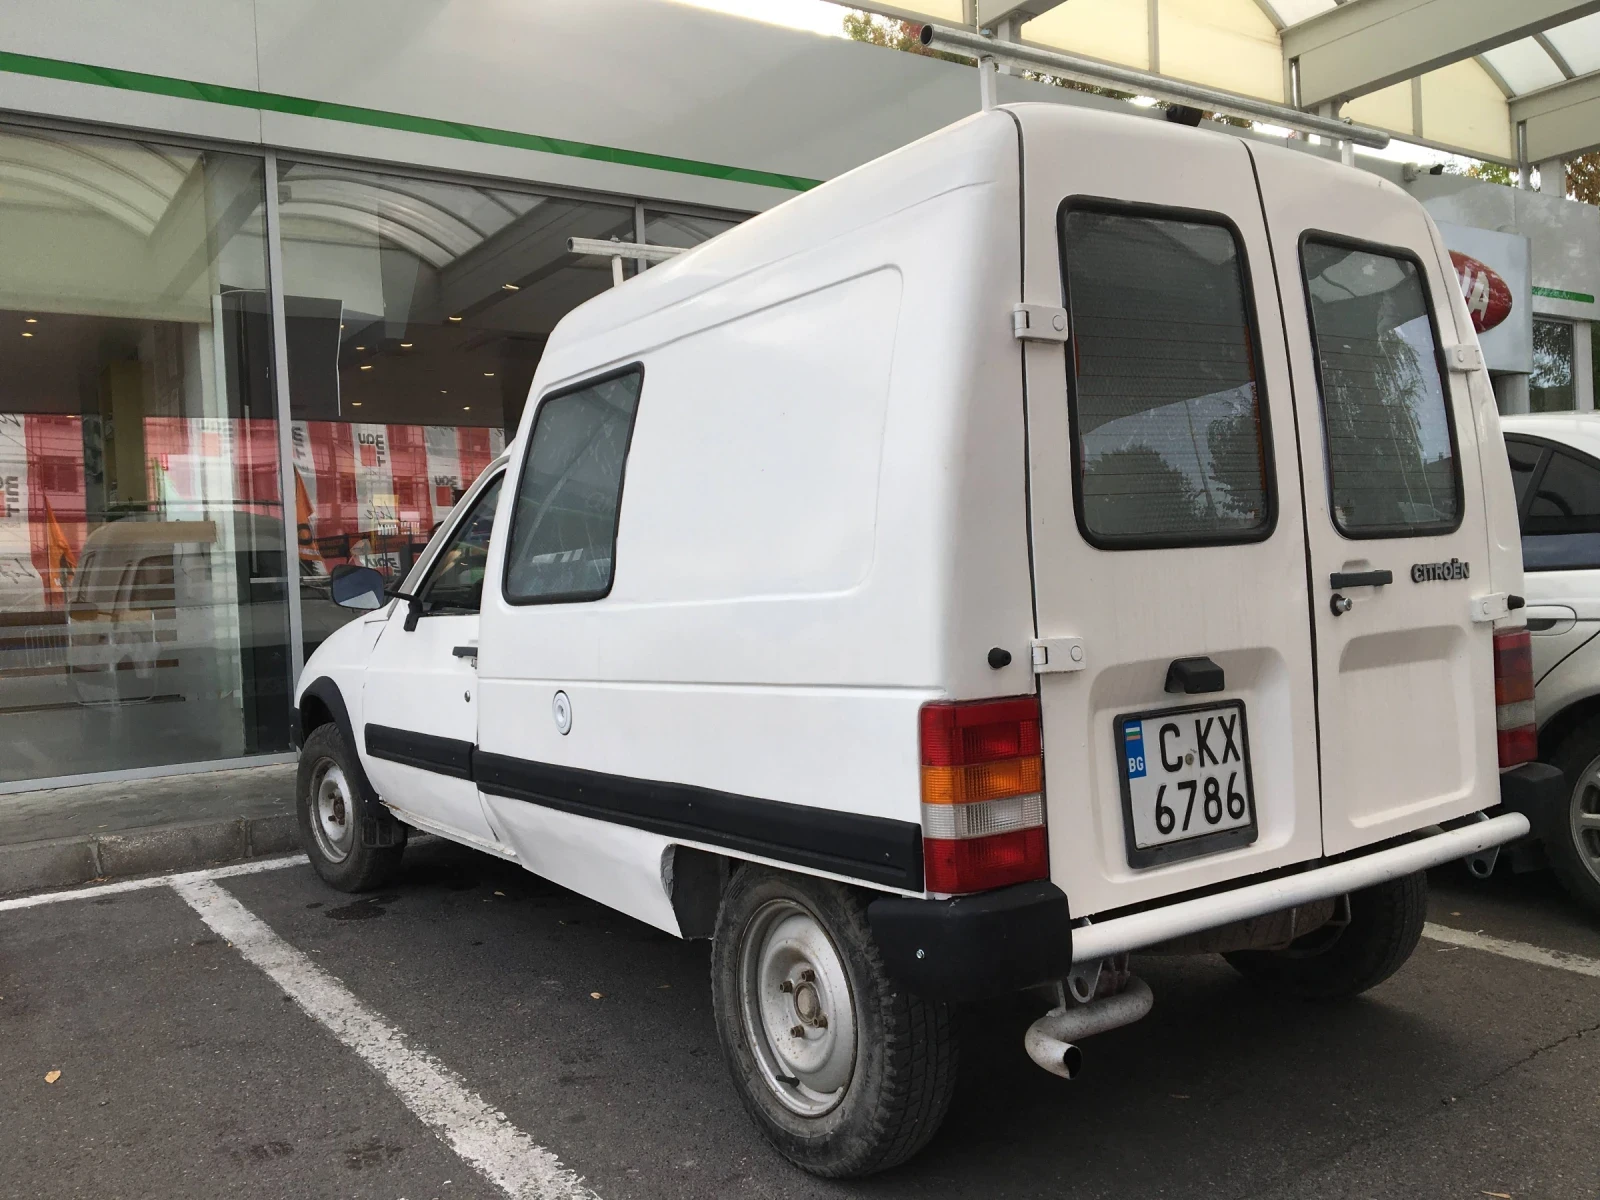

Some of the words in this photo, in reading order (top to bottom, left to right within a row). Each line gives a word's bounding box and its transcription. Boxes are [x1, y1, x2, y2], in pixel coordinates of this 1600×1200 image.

[1411, 557, 1470, 583] CITROËN
[1159, 722, 1183, 772] C
[1195, 713, 1241, 767] KX
[1128, 756, 1144, 773] BG
[1155, 771, 1245, 835] 6786
